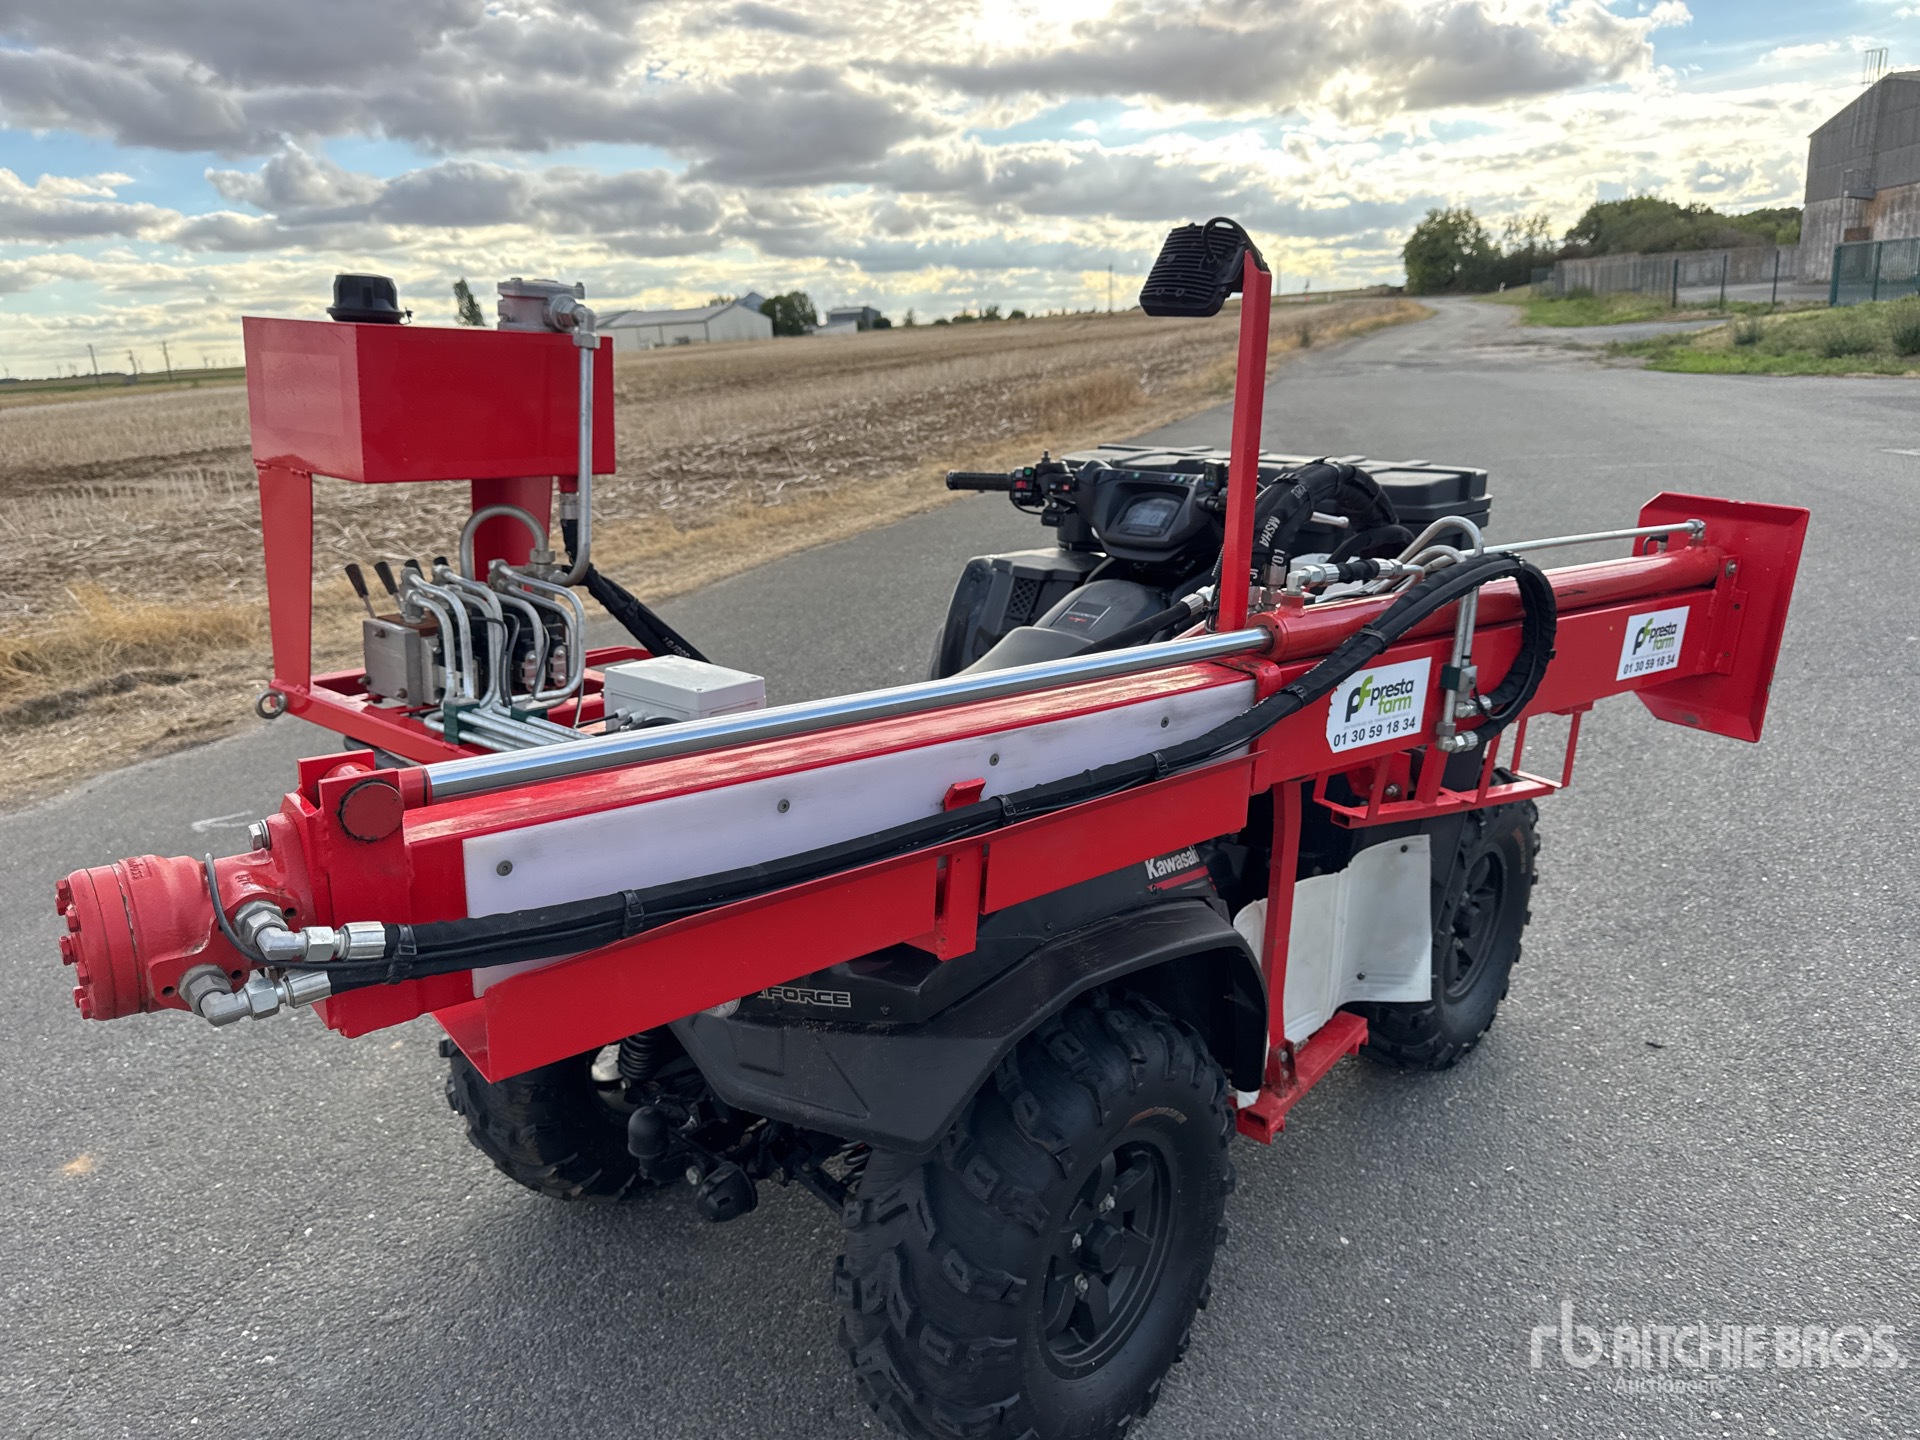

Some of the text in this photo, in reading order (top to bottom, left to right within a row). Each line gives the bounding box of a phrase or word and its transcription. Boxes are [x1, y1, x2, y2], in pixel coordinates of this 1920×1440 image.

[1259, 515, 1281, 548] MSHA
[1648, 622, 1678, 643] presta
[1652, 634, 1675, 652] farm
[1623, 664, 1634, 675] 01
[1634, 660, 1645, 672] 30
[1645, 658, 1655, 670] 59
[1656, 656, 1666, 667] 18
[1666, 653, 1676, 665] 34
[1369, 678, 1415, 706] presta
[1377, 695, 1412, 715] farm
[1333, 732, 1348, 747] 01
[1351, 728, 1366, 743] 30
[1368, 724, 1383, 739] 59
[1386, 720, 1400, 735] 18
[1402, 716, 1416, 731] 34
[1144, 844, 1201, 880] Kawasaki
